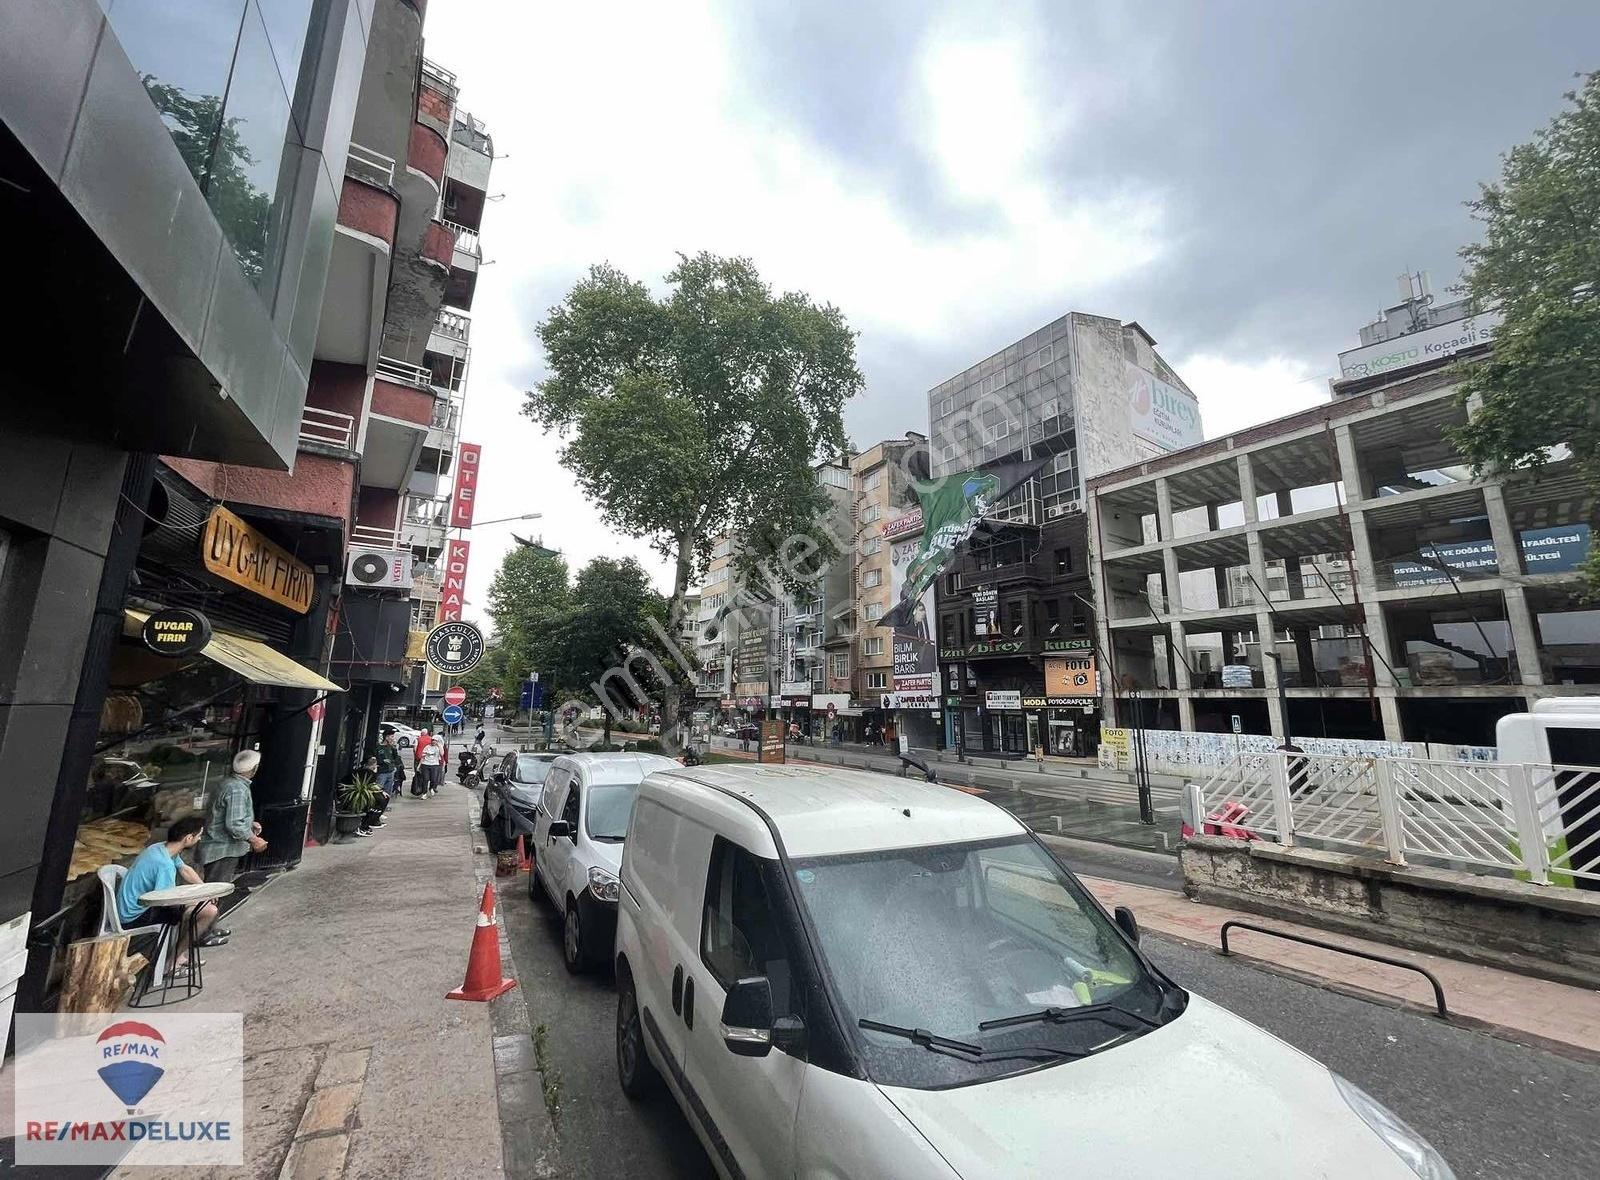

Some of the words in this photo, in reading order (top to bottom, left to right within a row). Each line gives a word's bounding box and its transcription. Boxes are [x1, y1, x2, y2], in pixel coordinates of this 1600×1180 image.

[1424, 331, 1476, 354] Kocaeli
[1151, 379, 1197, 430] birey
[457, 451, 478, 520] OTEL
[444, 546, 466, 621] KONAK
[157, 633, 187, 642] FIRIN
[432, 625, 480, 645] MASCULINE
[1044, 640, 1091, 650] kursu
[1065, 660, 1091, 671] FOTO
